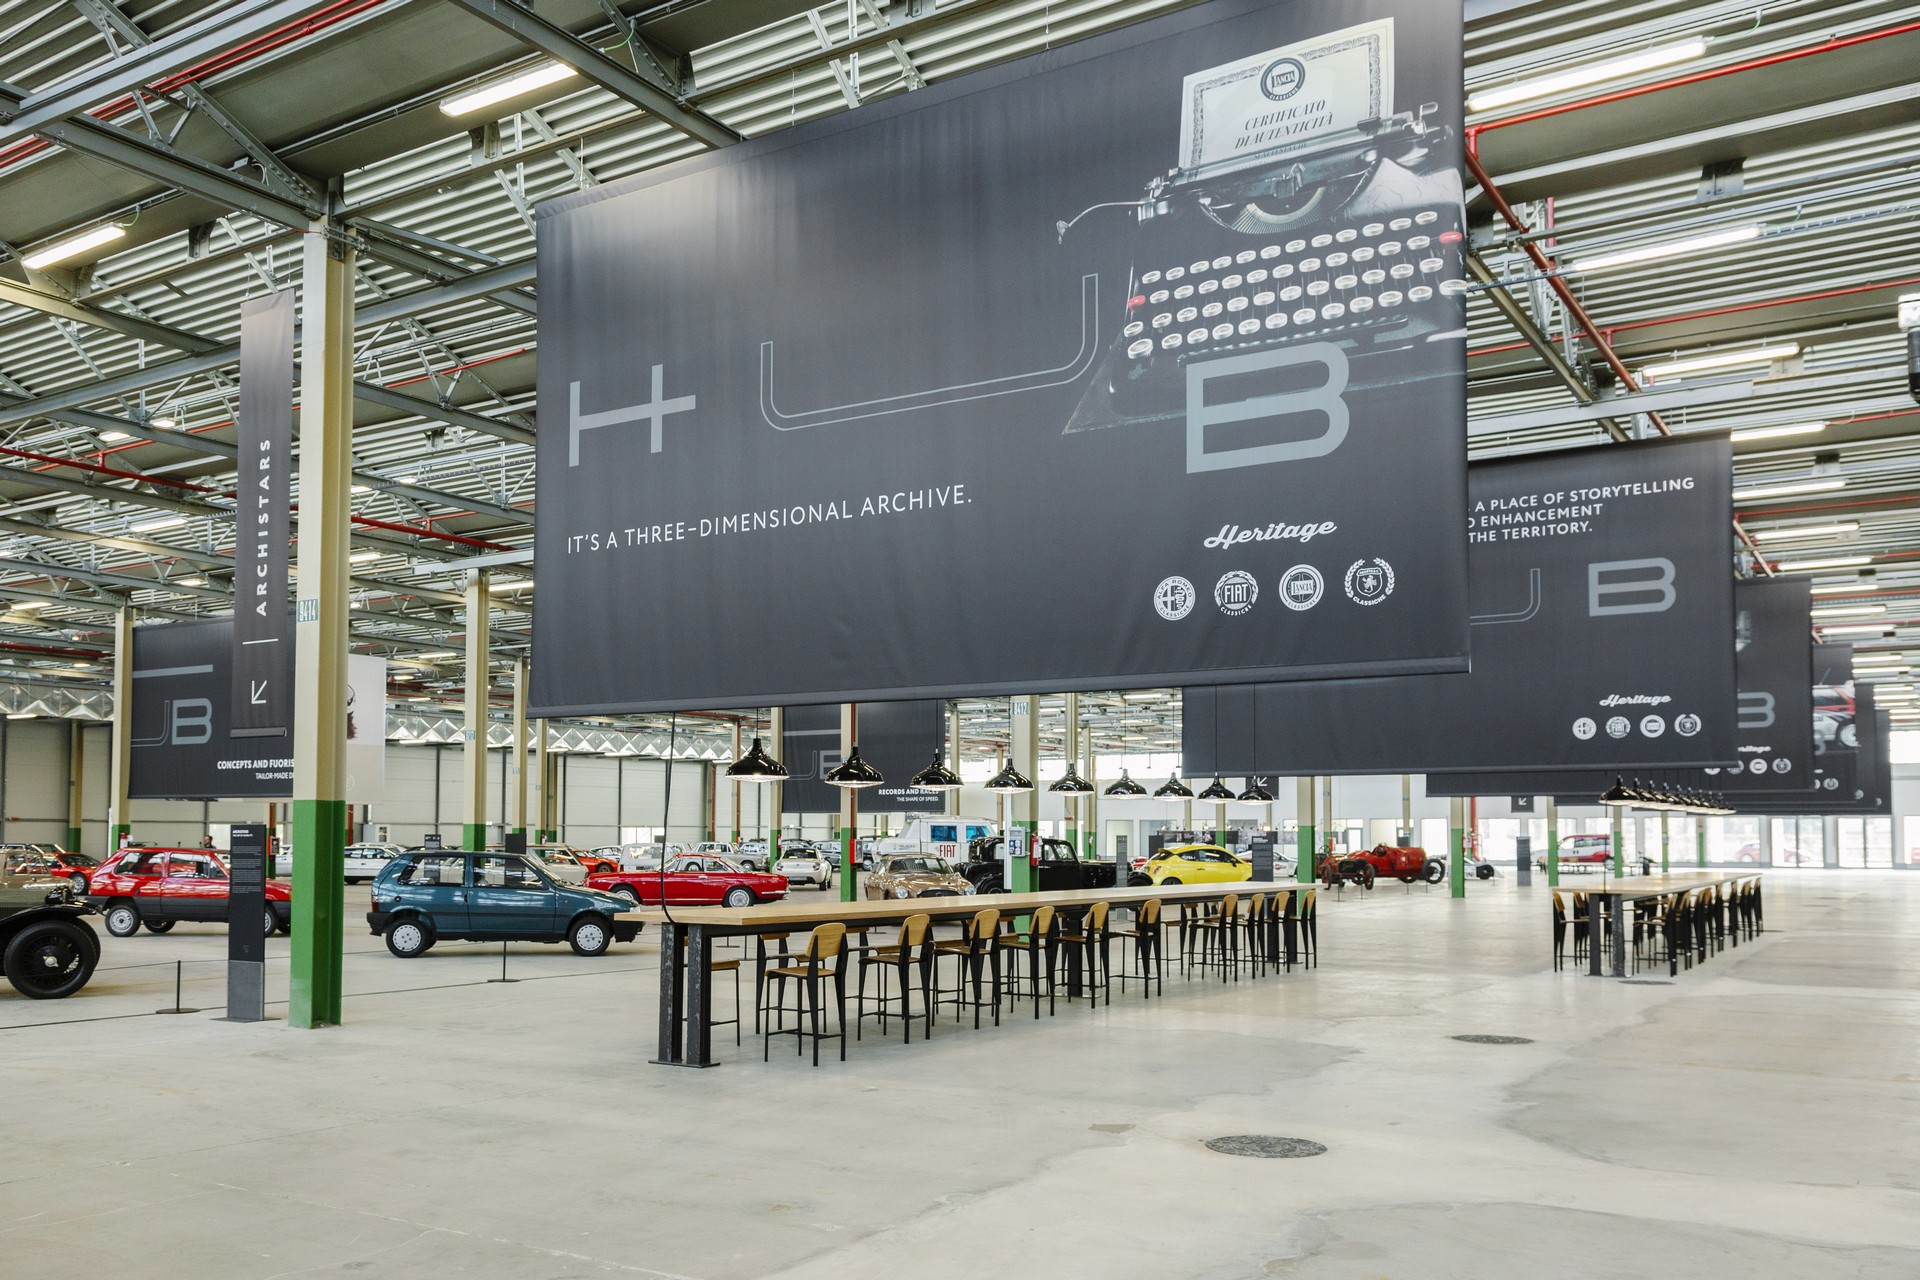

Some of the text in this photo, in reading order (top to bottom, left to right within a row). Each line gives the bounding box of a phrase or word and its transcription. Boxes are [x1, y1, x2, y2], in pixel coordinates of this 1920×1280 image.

[1244, 99, 1326, 131] CERTIFICATO
[1474, 476, 1695, 513] A PLACE OF STORYTELLING
[568, 485, 972, 554] IT'S A THREE-DIMENSIONAL ARCHIVE.
[1480, 503, 1604, 527] ENHANCEMENT
[256, 439, 271, 617] ARCHISTARS
[1203, 521, 1338, 550] Heritage
[1468, 520, 1593, 544] THE TERRITORY.
[1157, 579, 1193, 600] ALFA ROMEO
[1224, 583, 1249, 603] FIAT
[1599, 694, 1672, 707] Heritage
[217, 760, 252, 769] CONCEPTS
[252, 759, 269, 768] AND
[255, 771, 289, 780] TAILOR-MADE
[939, 844, 956, 857] FIAT
